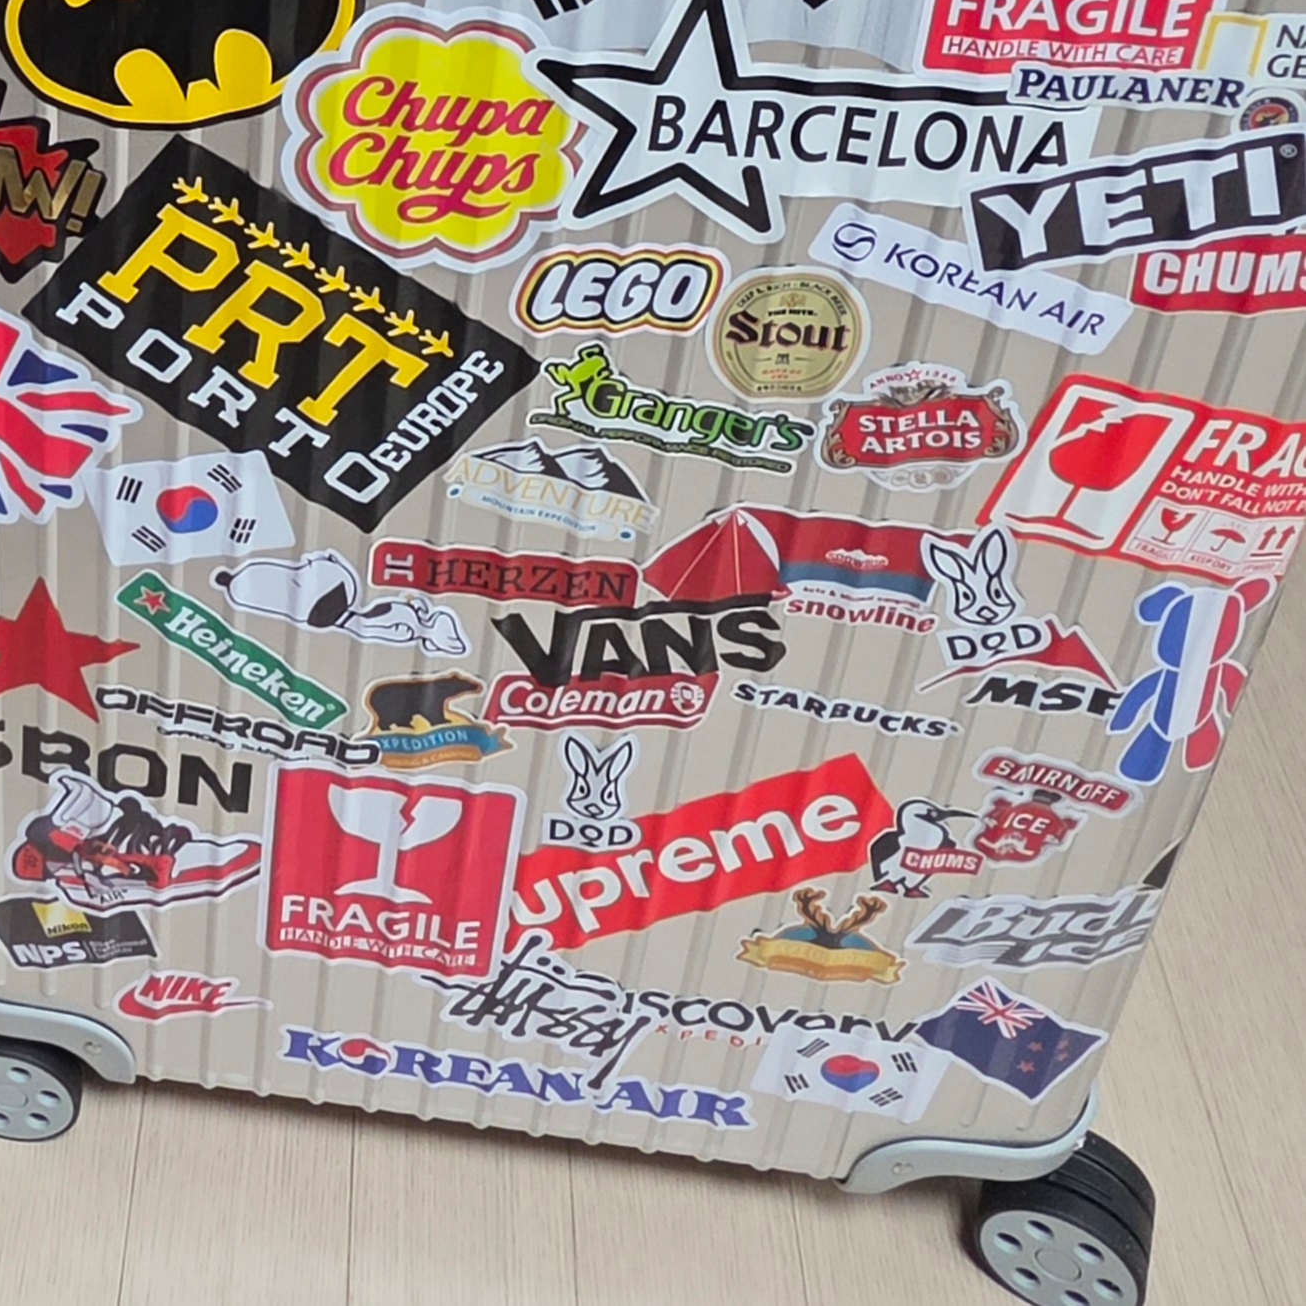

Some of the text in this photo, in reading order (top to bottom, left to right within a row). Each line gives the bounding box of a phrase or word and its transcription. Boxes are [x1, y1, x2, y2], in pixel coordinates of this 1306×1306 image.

[947, 35, 1181, 66] HANDLE WITH CARE
[1016, 67, 1246, 108] PAULANER
[342, 75, 557, 148] Chupa
[647, 94, 1070, 174] BARCELONA
[328, 132, 542, 225] Chups
[978, 146, 1282, 259] YETI
[531, 261, 712, 325] LEGO
[884, 243, 1106, 336] KOREAN AIR
[1142, 251, 1306, 296] CHUM
[98, 203, 429, 427] PRT
[725, 309, 851, 353] Stout
[869, 374, 904, 390] ANNO
[370, 349, 505, 473] EUROPE
[584, 378, 815, 452] Granger's
[859, 409, 980, 433] STELLA
[861, 430, 982, 454] ARTOIS
[447, 457, 657, 531] ADVENTURE
[1160, 480, 1296, 516] DON'T FALL NOT
[1170, 465, 1306, 499] HANDLE WITH
[482, 495, 536, 516] MOUNTAIN
[426, 557, 632, 600] HERZEN
[786, 598, 937, 634] snowline
[491, 593, 787, 688] VANS
[164, 605, 330, 723] Heineken
[499, 680, 666, 716] Coleman
[733, 683, 947, 737] STARBUCKS
[95, 686, 381, 765] OFFROAD
[378, 729, 469, 751] XPEDITION
[994, 758, 1121, 805] SMIRNOFF
[1002, 811, 1051, 836] ICE
[510, 794, 862, 934] upreme
[904, 850, 980, 872] CHUMS
[46, 922, 90, 937] Nikon
[281, 895, 482, 951] FRAGILE
[12, 941, 87, 965] NPS
[280, 928, 477, 969] HANDLE WITH CARE
[136, 974, 233, 1006] NIKE
[655, 1023, 765, 1049] XPEDI
[596, 1081, 753, 1128] AIR
